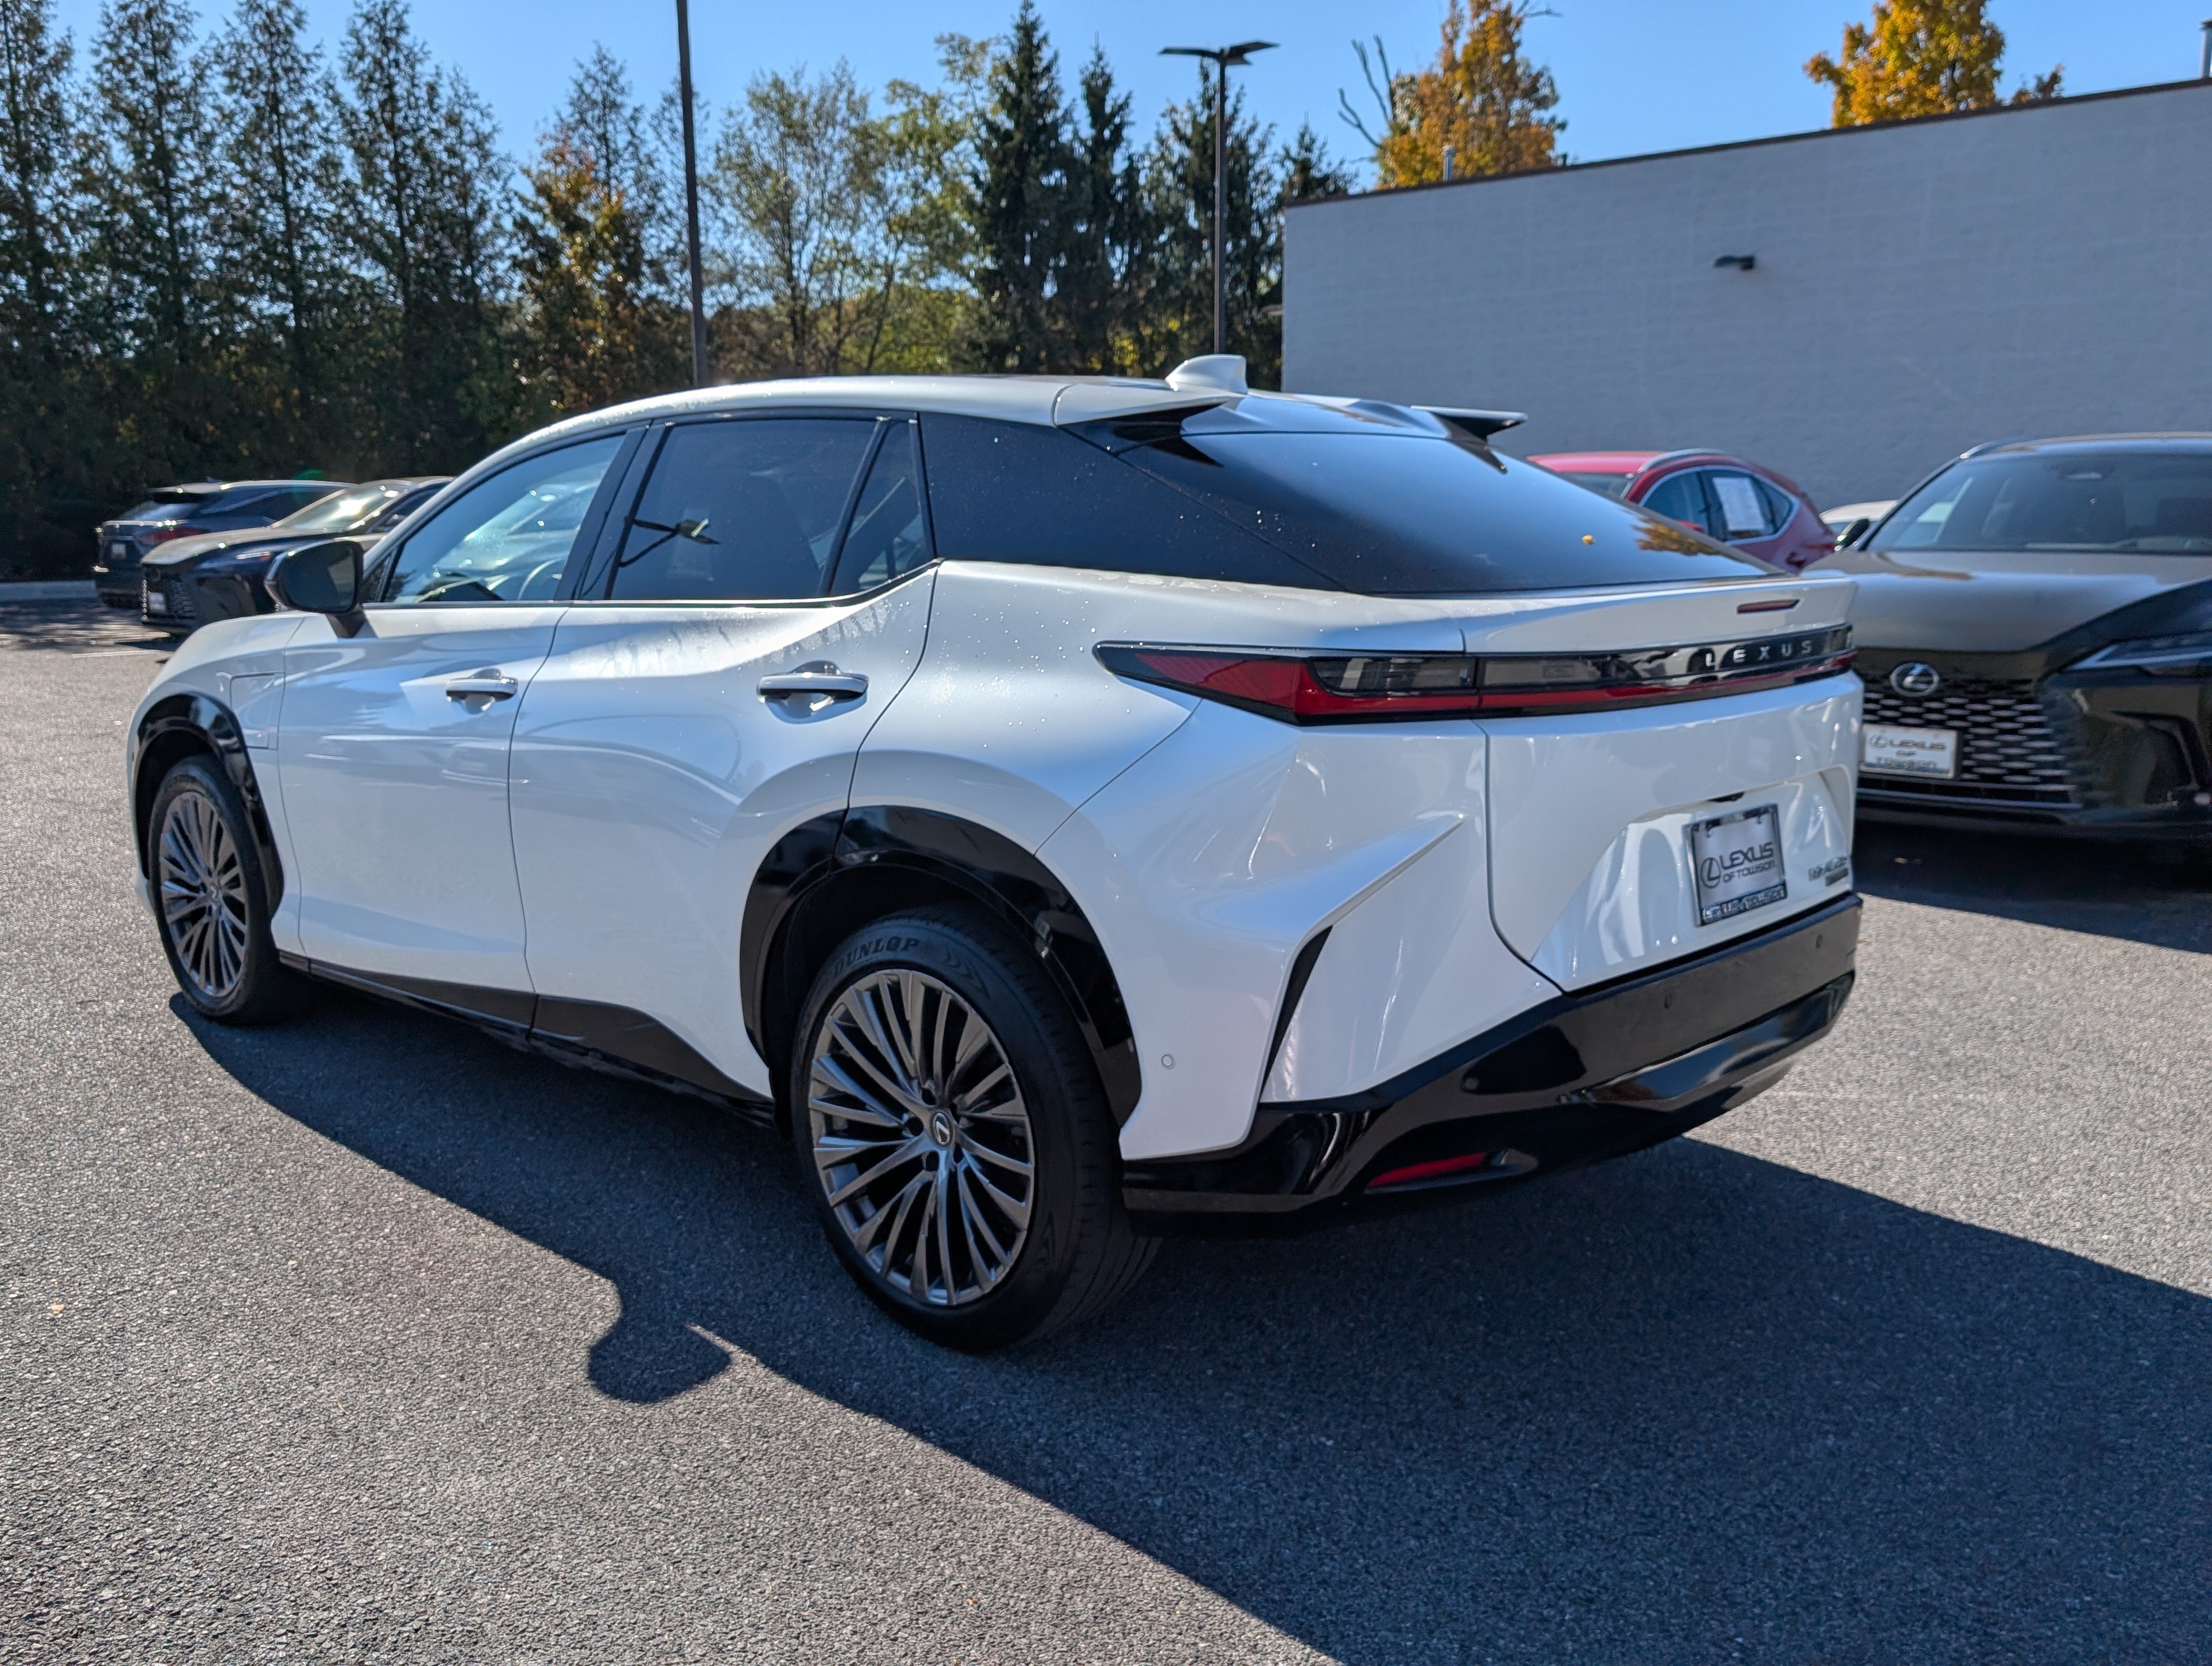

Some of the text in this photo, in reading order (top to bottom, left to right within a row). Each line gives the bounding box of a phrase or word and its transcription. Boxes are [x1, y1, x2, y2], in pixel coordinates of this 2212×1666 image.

[1705, 639, 1812, 667] LEXUS
[1719, 841, 1774, 870] LEXUS
[1722, 871, 1734, 883] OF
[834, 935, 922, 976] DUNLOP
